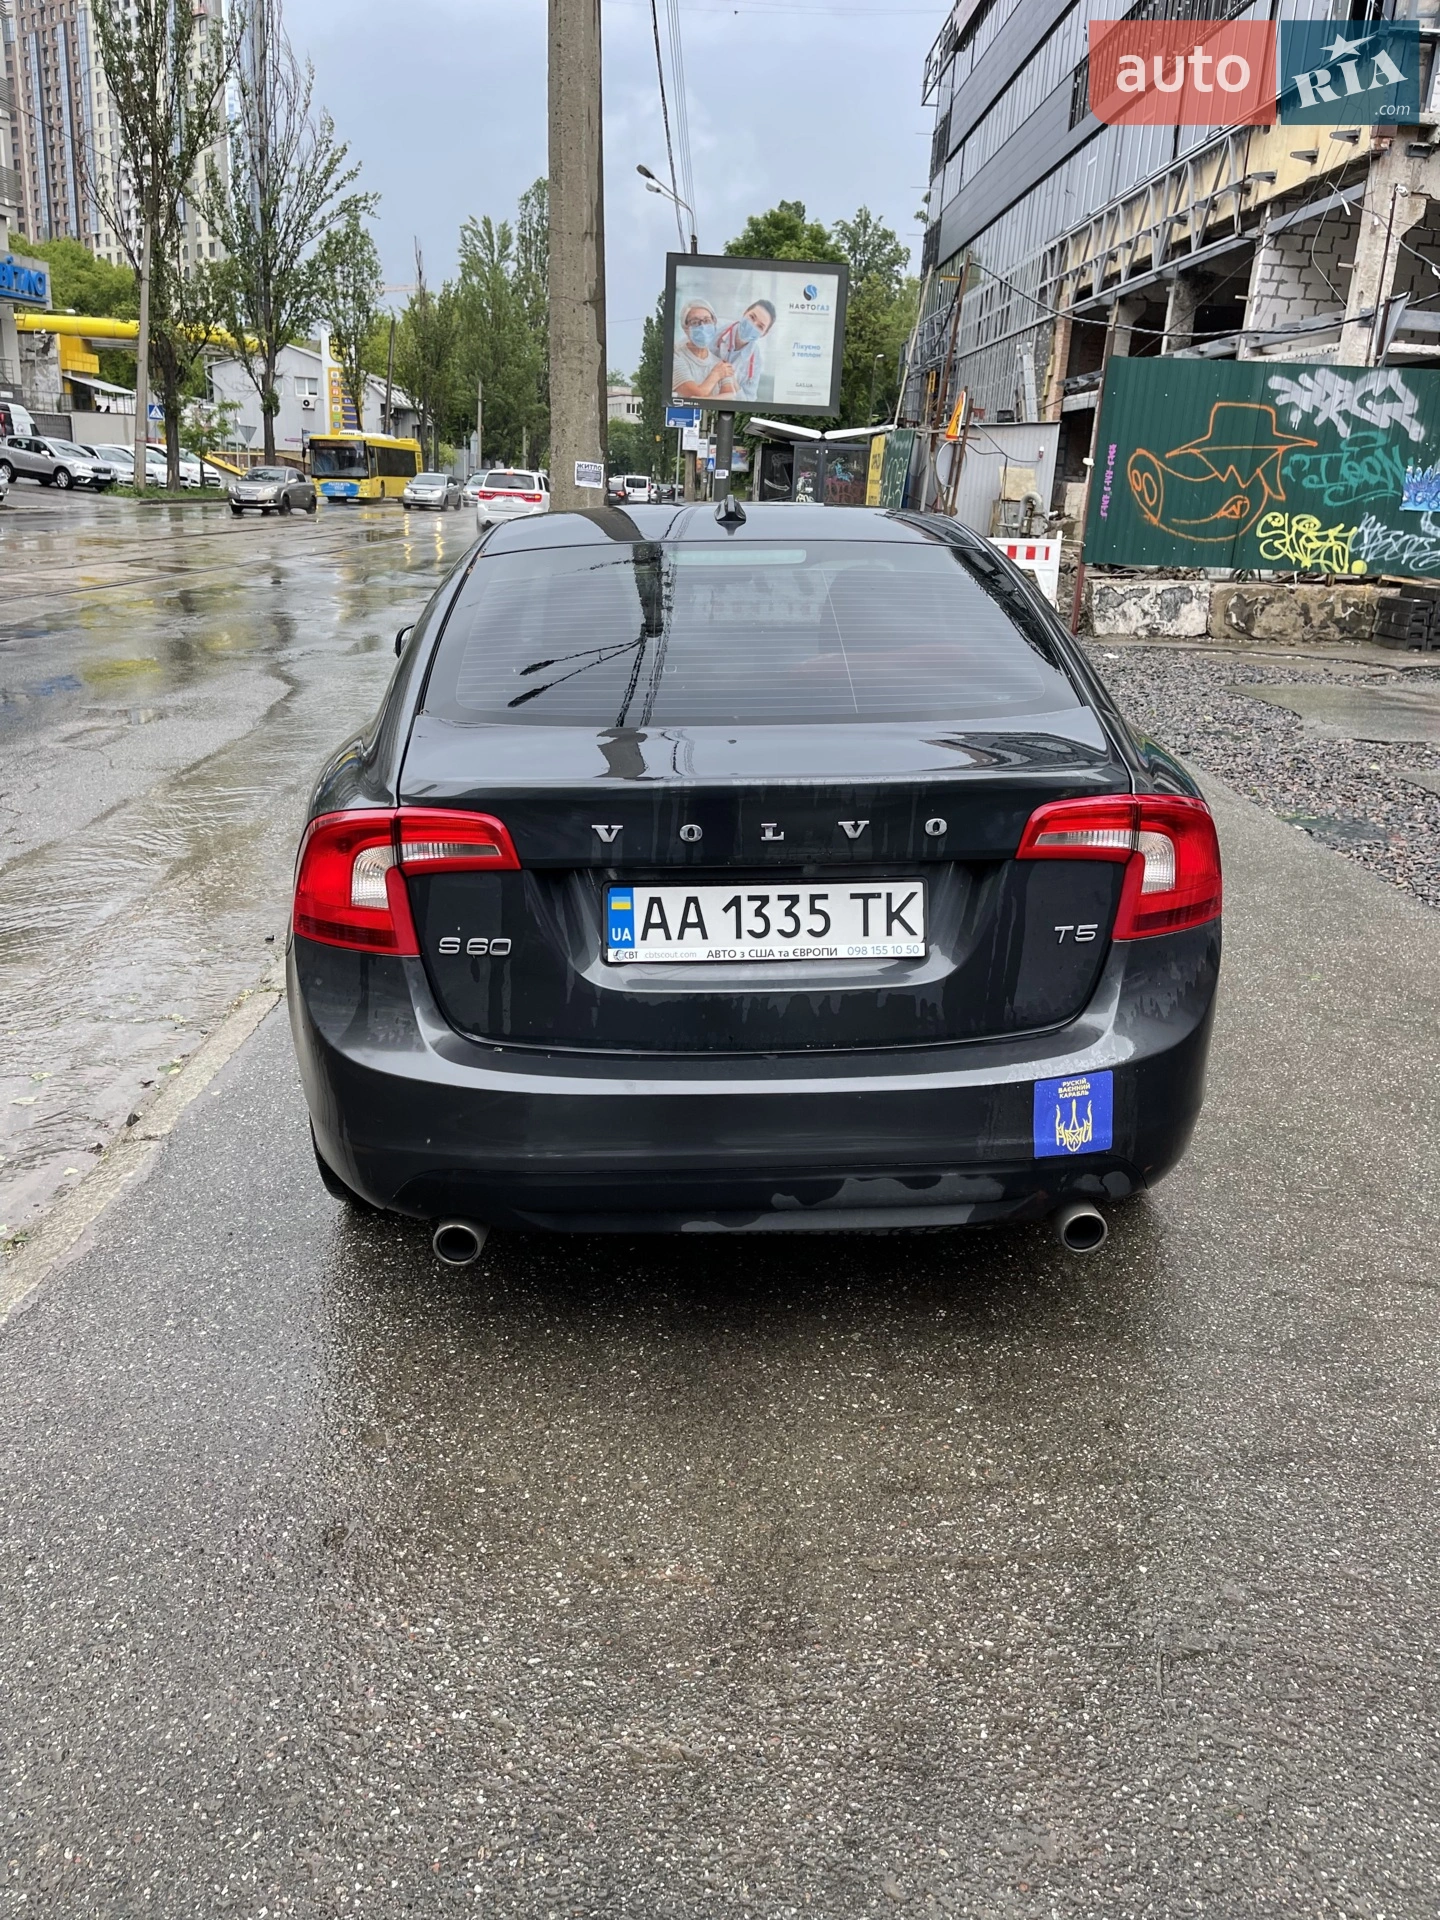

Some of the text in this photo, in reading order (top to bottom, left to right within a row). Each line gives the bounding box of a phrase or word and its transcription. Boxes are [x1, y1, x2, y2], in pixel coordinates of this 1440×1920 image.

[788, 302, 830, 312] НАФТОГАЗ
[576, 462, 602, 471] ЖИТЛО
[591, 817, 948, 843] VOLVO
[721, 893, 831, 940] 1335
[611, 927, 632, 941] UA
[1054, 923, 1098, 944] T5
[644, 951, 697, 959] cbtscout.com
[706, 949, 737, 959] АВТО
[748, 949, 775, 958] США
[777, 949, 790, 958] та
[792, 947, 838, 957] ЄВРОПИ
[847, 945, 868, 956] 098
[870, 945, 889, 956] 155
[891, 945, 903, 955] 10
[906, 944, 920, 954] 50
